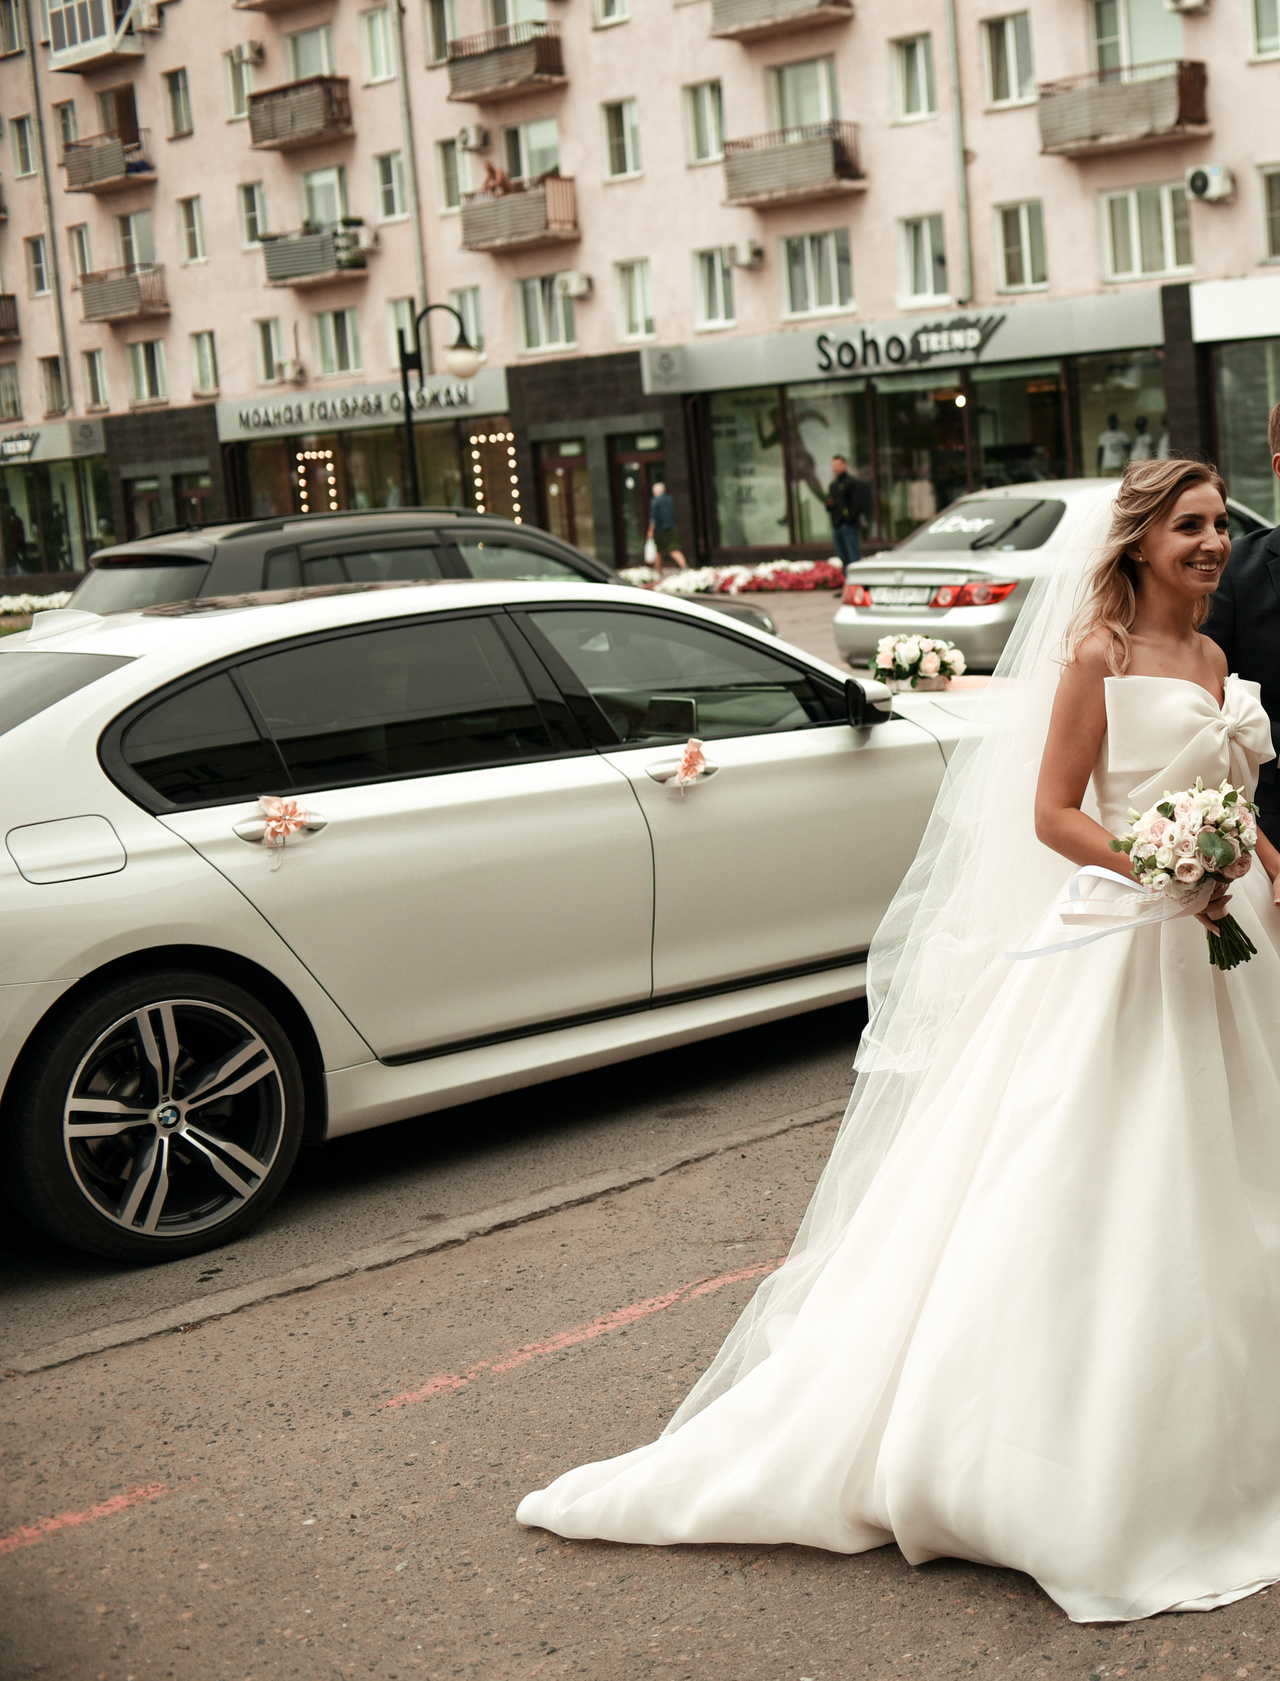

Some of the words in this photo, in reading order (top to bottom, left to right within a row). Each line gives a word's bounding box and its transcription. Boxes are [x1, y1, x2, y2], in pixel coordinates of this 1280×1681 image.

[816, 328, 906, 372] Soho
[917, 328, 982, 354] TREND
[928, 515, 995, 534] Uber
